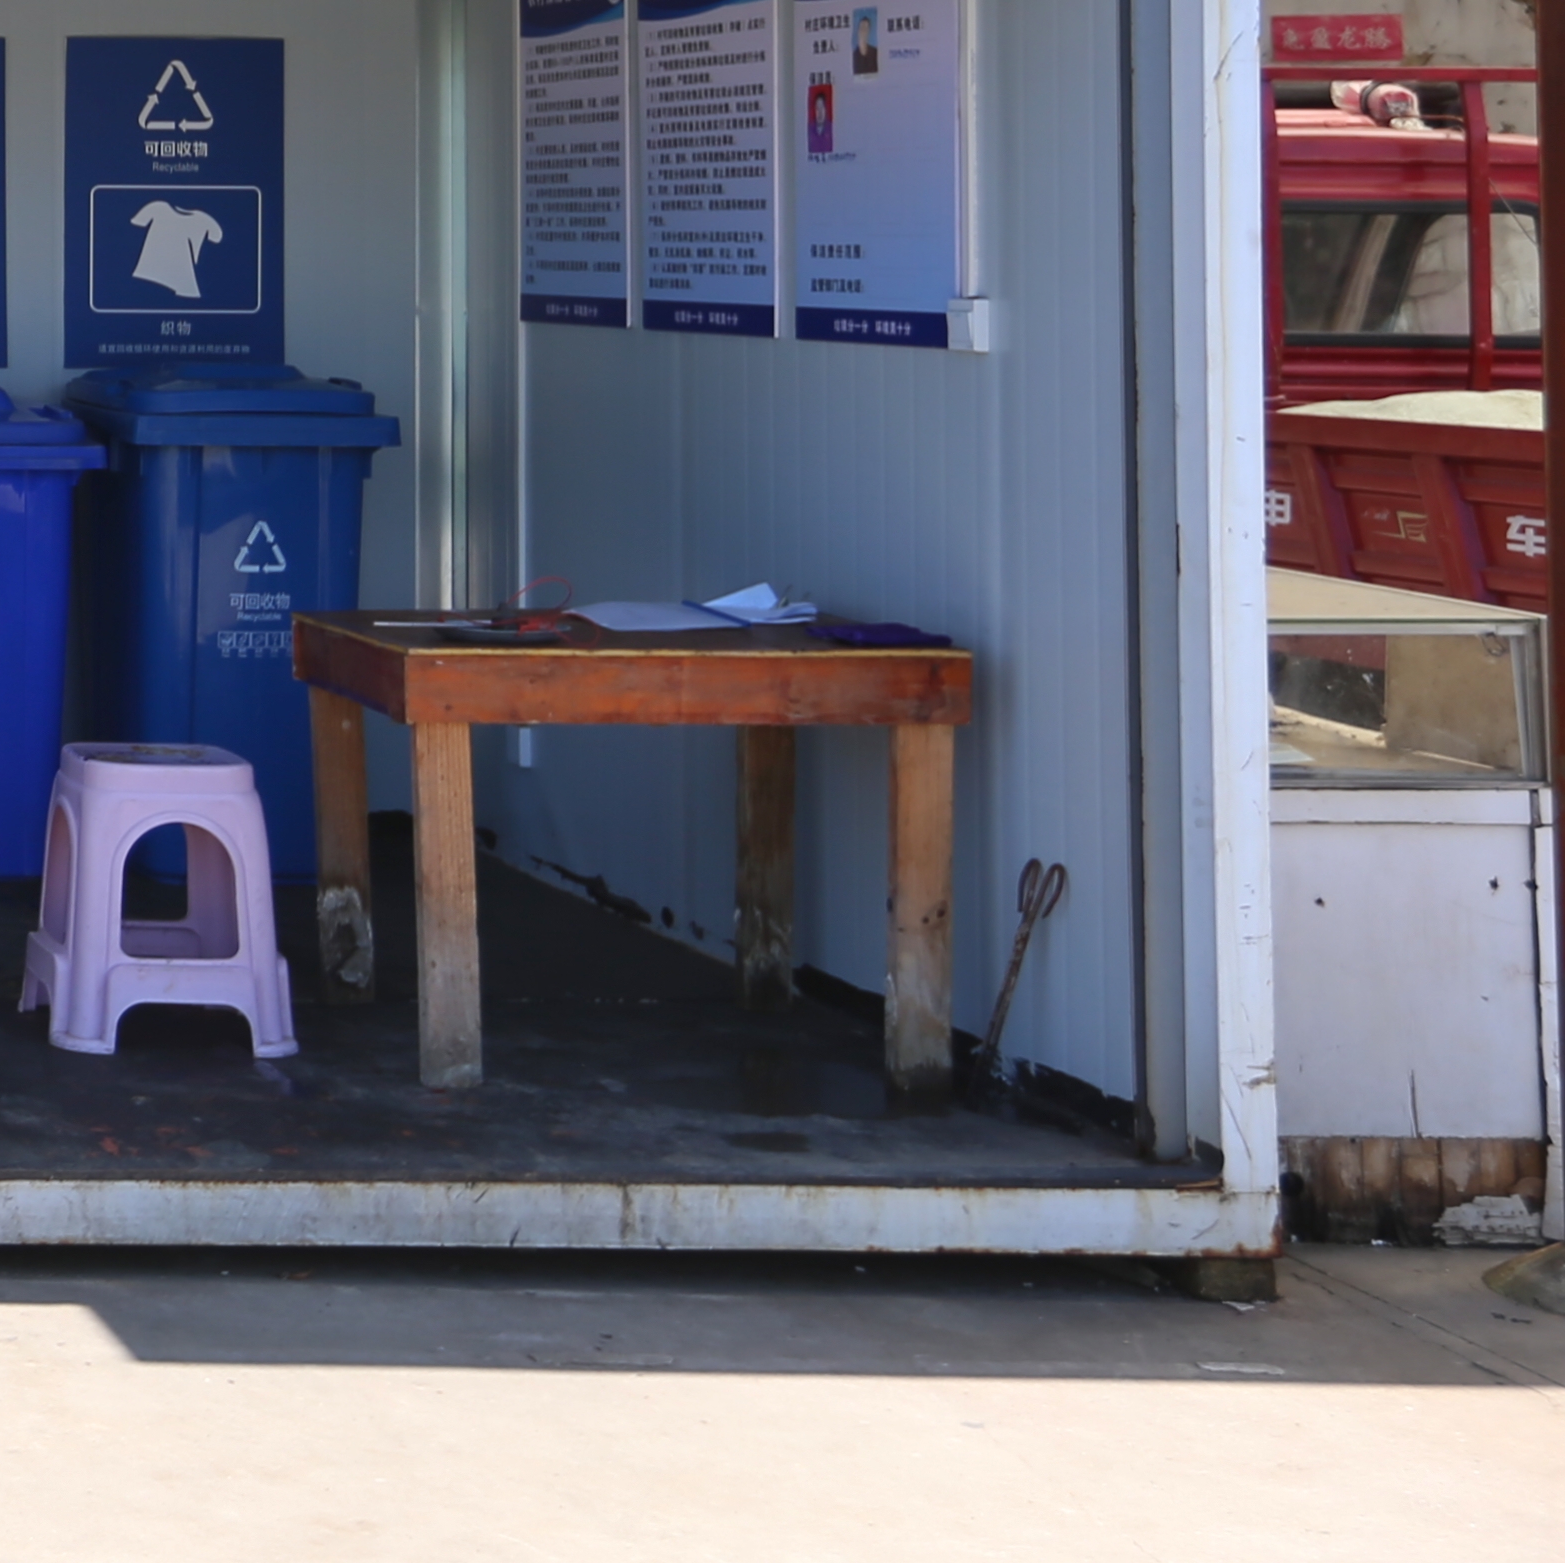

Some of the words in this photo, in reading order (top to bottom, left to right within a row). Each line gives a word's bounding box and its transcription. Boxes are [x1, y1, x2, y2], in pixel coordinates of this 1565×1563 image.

[144, 141, 208, 157] 可回收物
[152, 161, 199, 173] Recyclable
[161, 320, 191, 336] 织物
[229, 592, 290, 610] 可回收物
